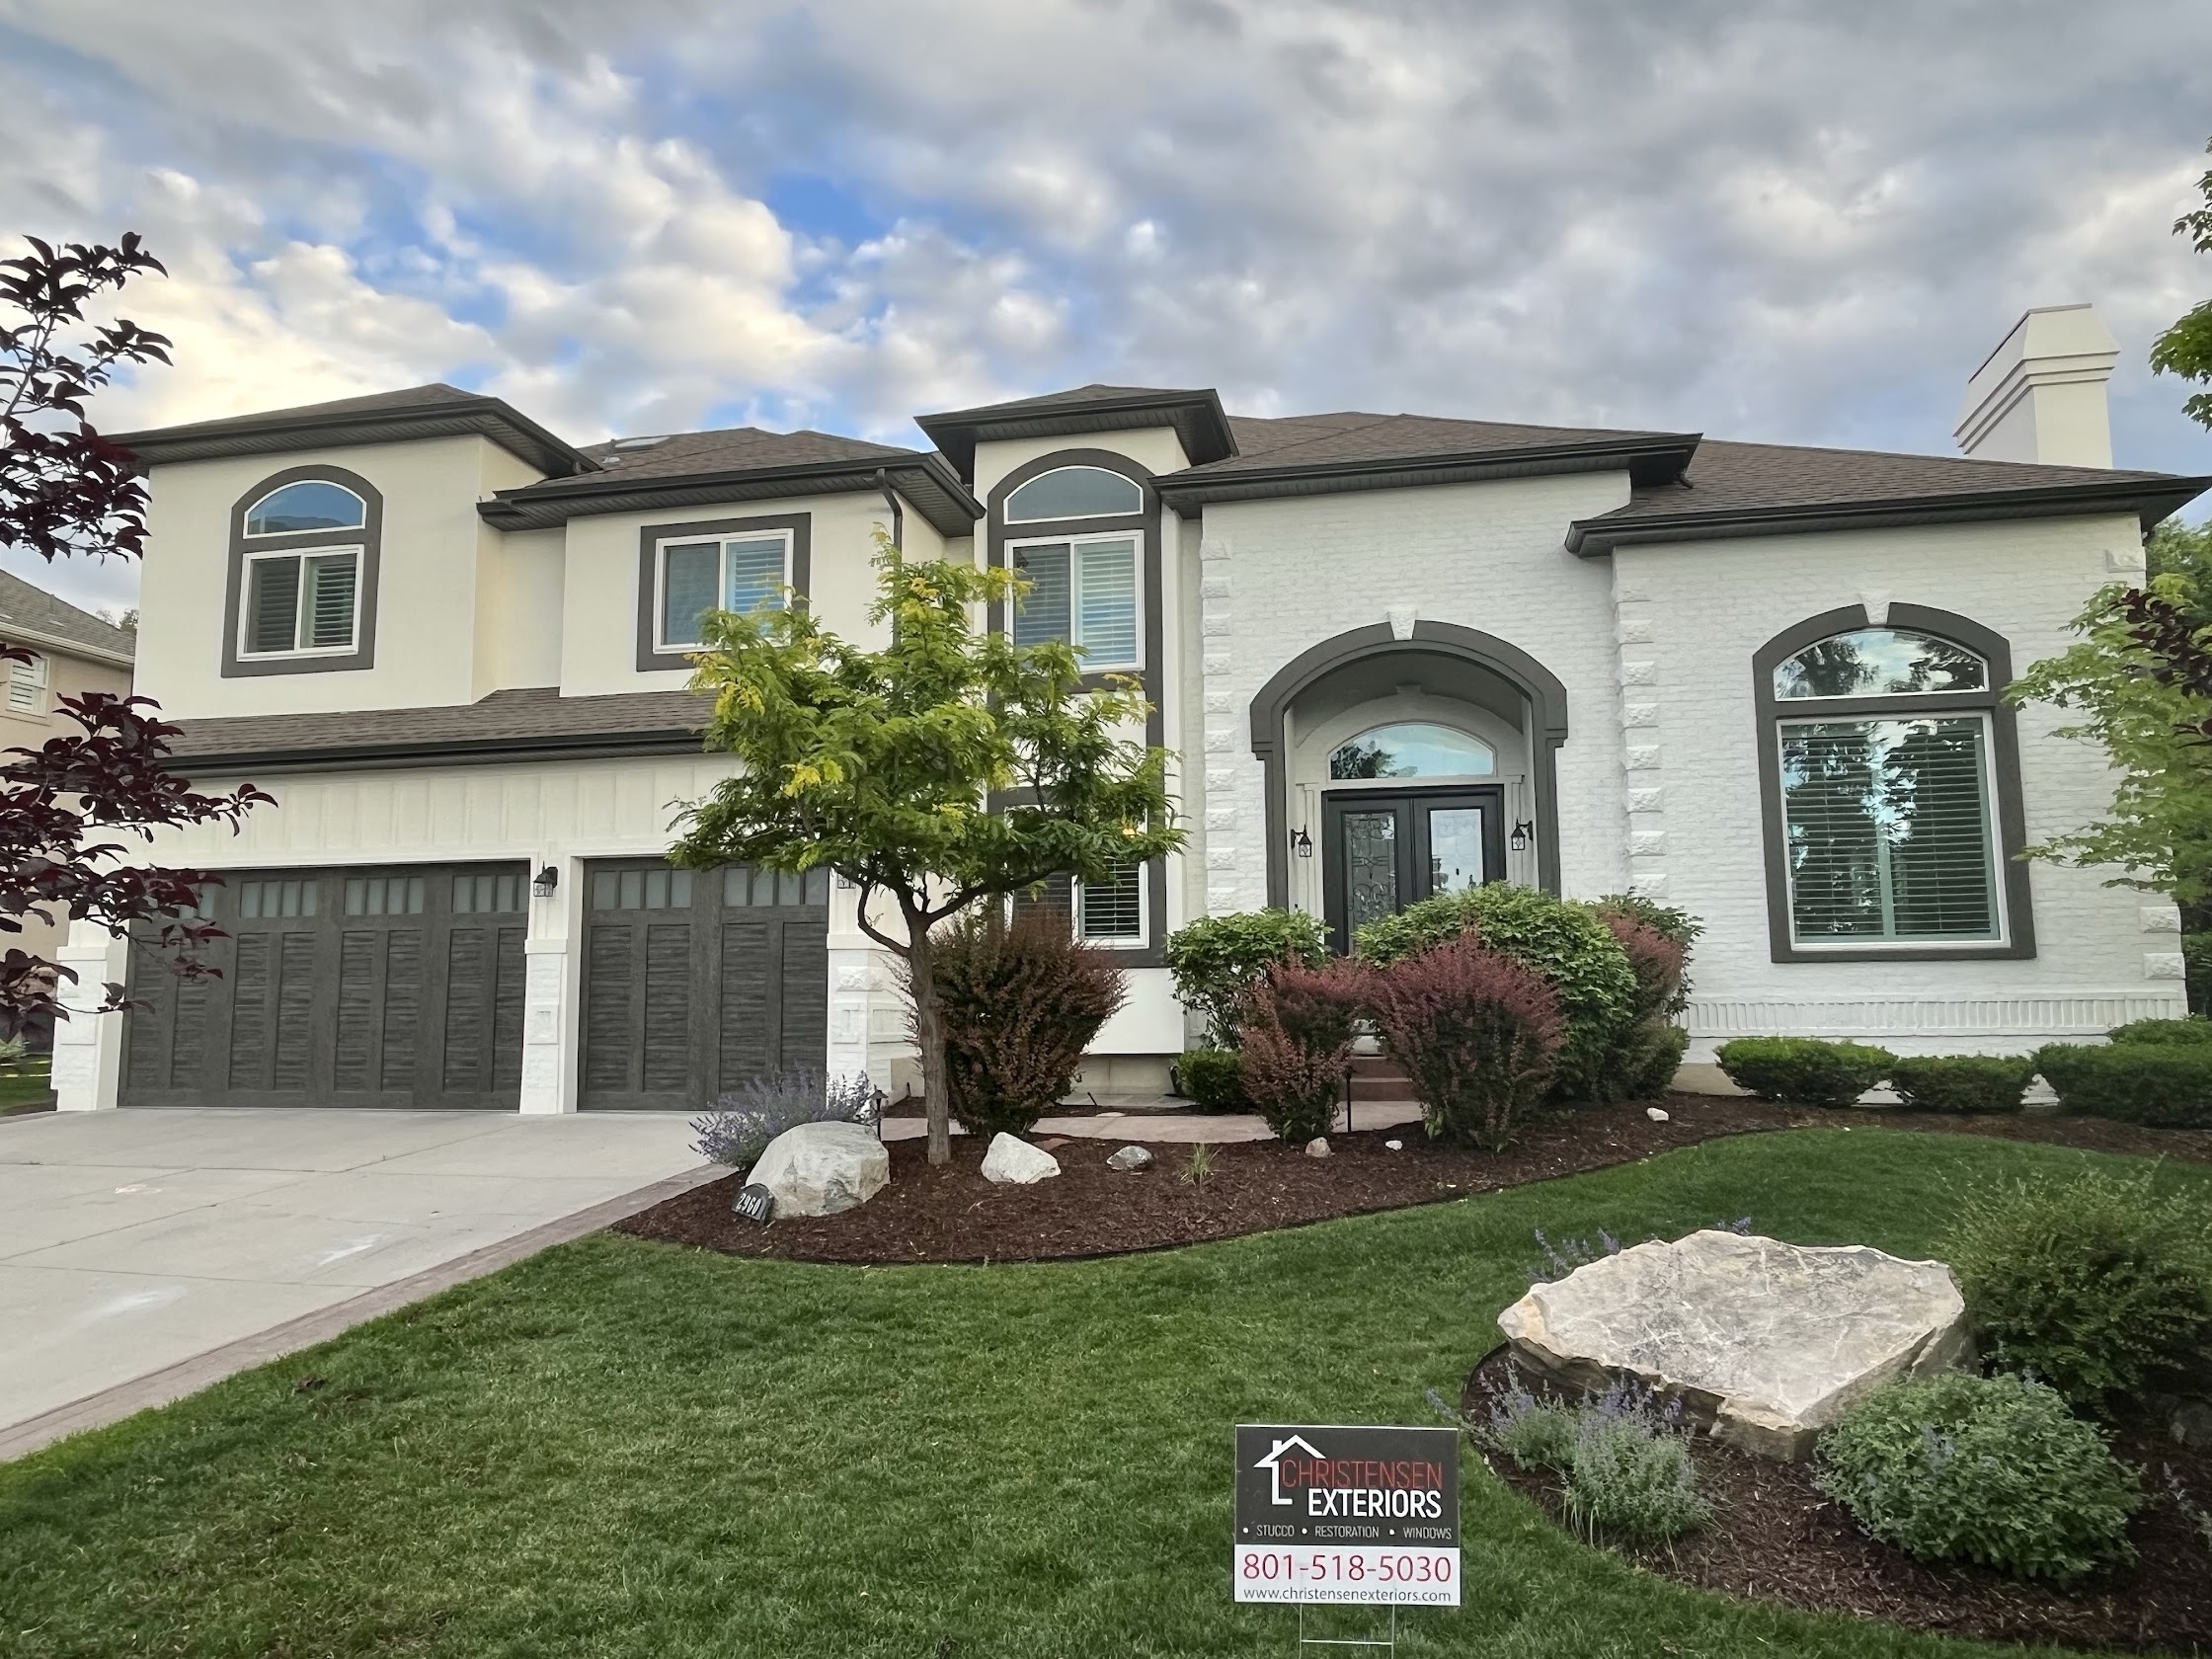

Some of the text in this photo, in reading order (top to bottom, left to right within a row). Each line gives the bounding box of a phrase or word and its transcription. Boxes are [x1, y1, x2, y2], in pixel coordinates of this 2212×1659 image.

[1282, 1459, 1443, 1490] CHRISTENSEN
[1308, 1488, 1443, 1519] EXTERIORS
[1256, 1525, 1453, 1540] STUCCO RESTORATION WINDOWS
[1243, 1553, 1452, 1583] 801-518-5030
[1243, 1587, 1452, 1603] www.christensenexteriors.com
